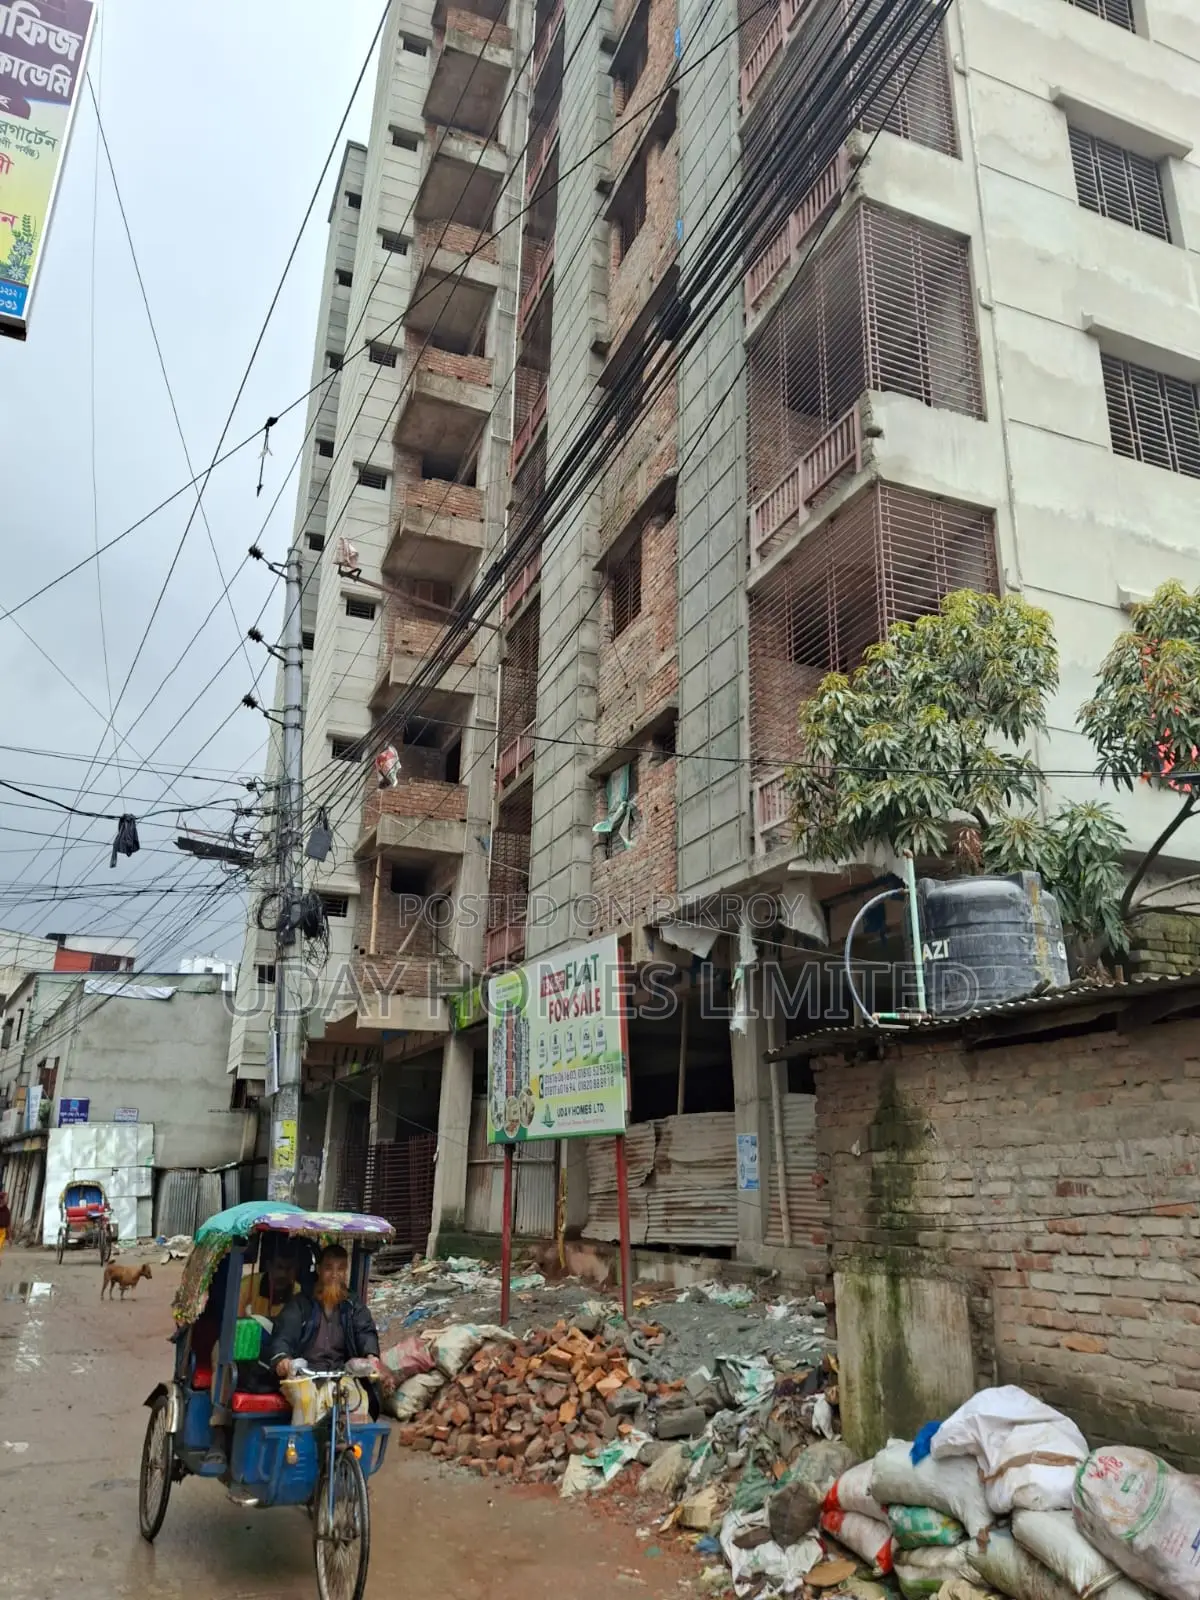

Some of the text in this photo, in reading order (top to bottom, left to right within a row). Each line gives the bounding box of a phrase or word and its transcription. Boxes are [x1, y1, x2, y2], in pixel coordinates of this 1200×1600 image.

[914, 938, 950, 961] AZI
[565, 953, 599, 990] FLAT
[549, 987, 601, 1024] FOR SALE
